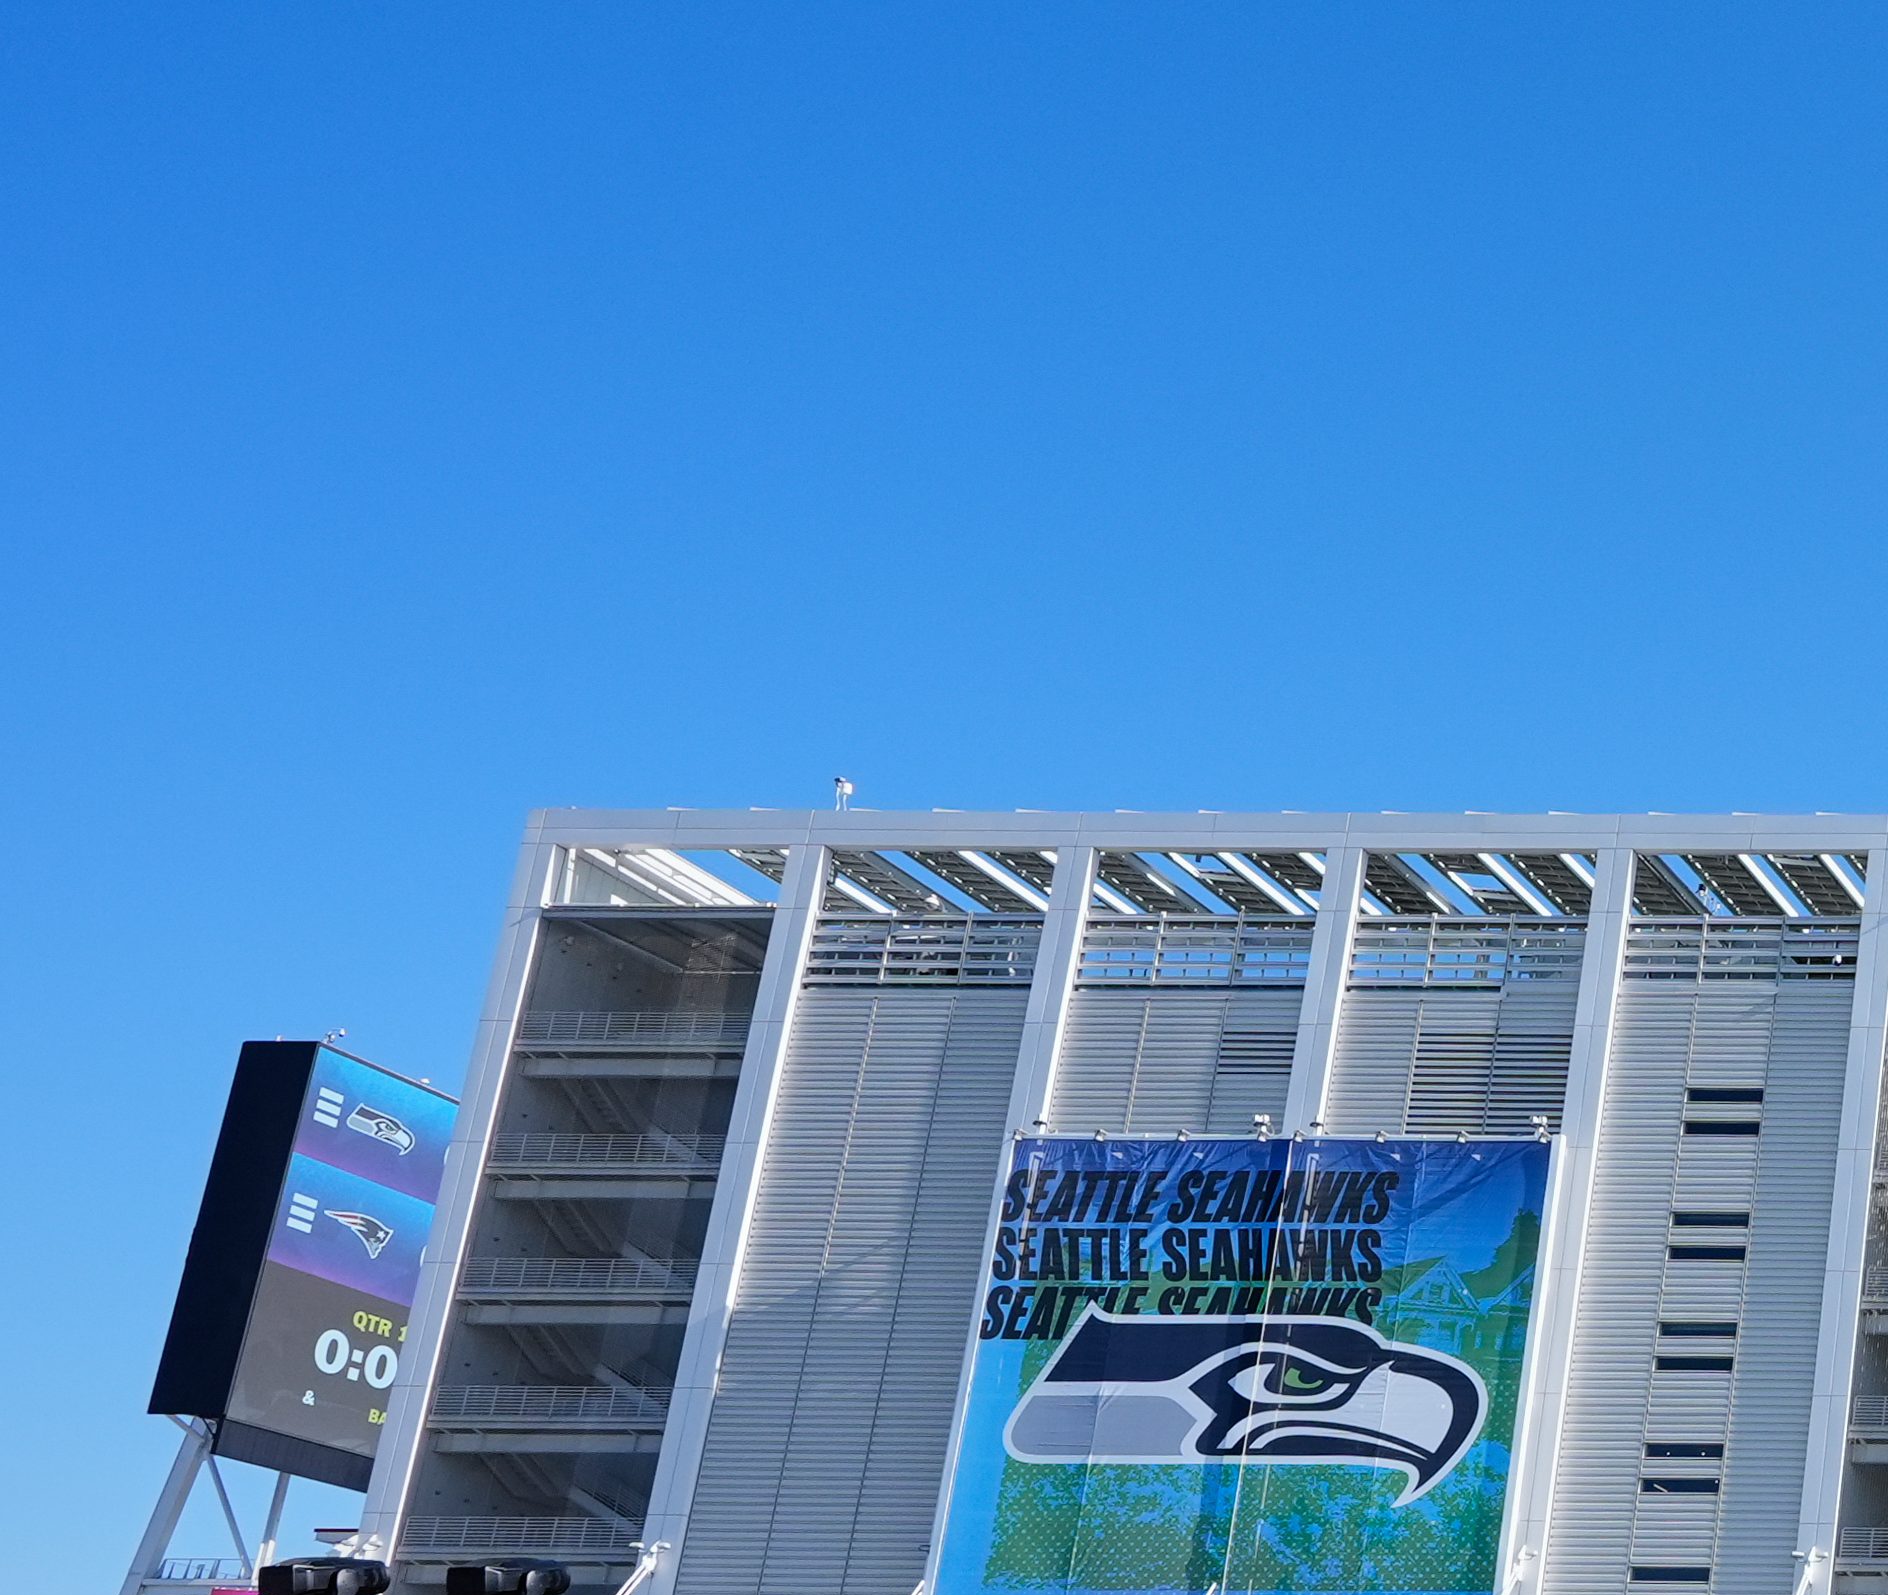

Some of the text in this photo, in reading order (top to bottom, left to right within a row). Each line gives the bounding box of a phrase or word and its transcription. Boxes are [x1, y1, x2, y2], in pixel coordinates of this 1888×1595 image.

[1000, 1169, 1400, 1225] SEATTLE SEAHAWKS
[992, 1227, 1382, 1282] SEATTLE SEAHAWKS
[353, 1311, 393, 1337] QTR
[314, 1329, 398, 1389] 0:0
[302, 1390, 315, 1406] &
